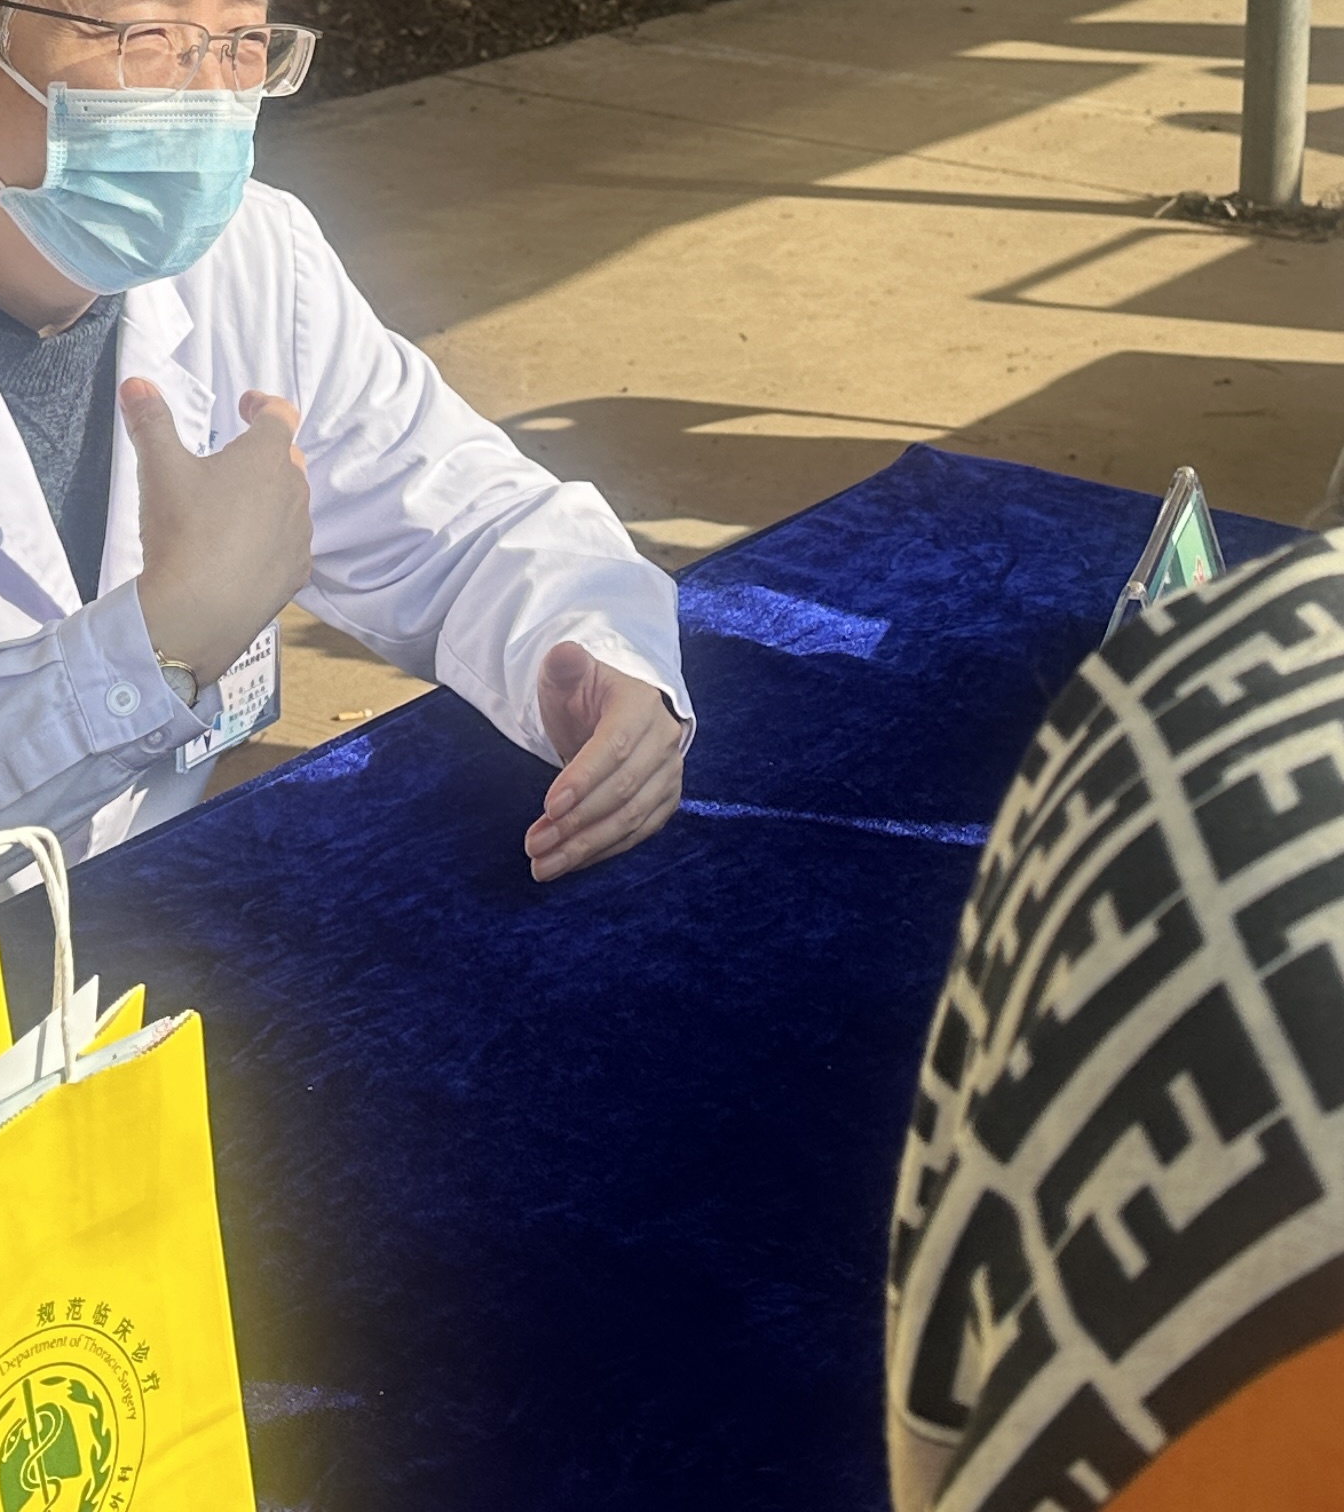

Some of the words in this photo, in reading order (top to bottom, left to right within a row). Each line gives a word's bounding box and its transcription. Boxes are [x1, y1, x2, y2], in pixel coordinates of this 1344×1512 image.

[0, 1335, 67, 1377] Department
[69, 1334, 84, 1348] of
[83, 1334, 122, 1376] Thoracic
[118, 1370, 137, 1420] Surgery
